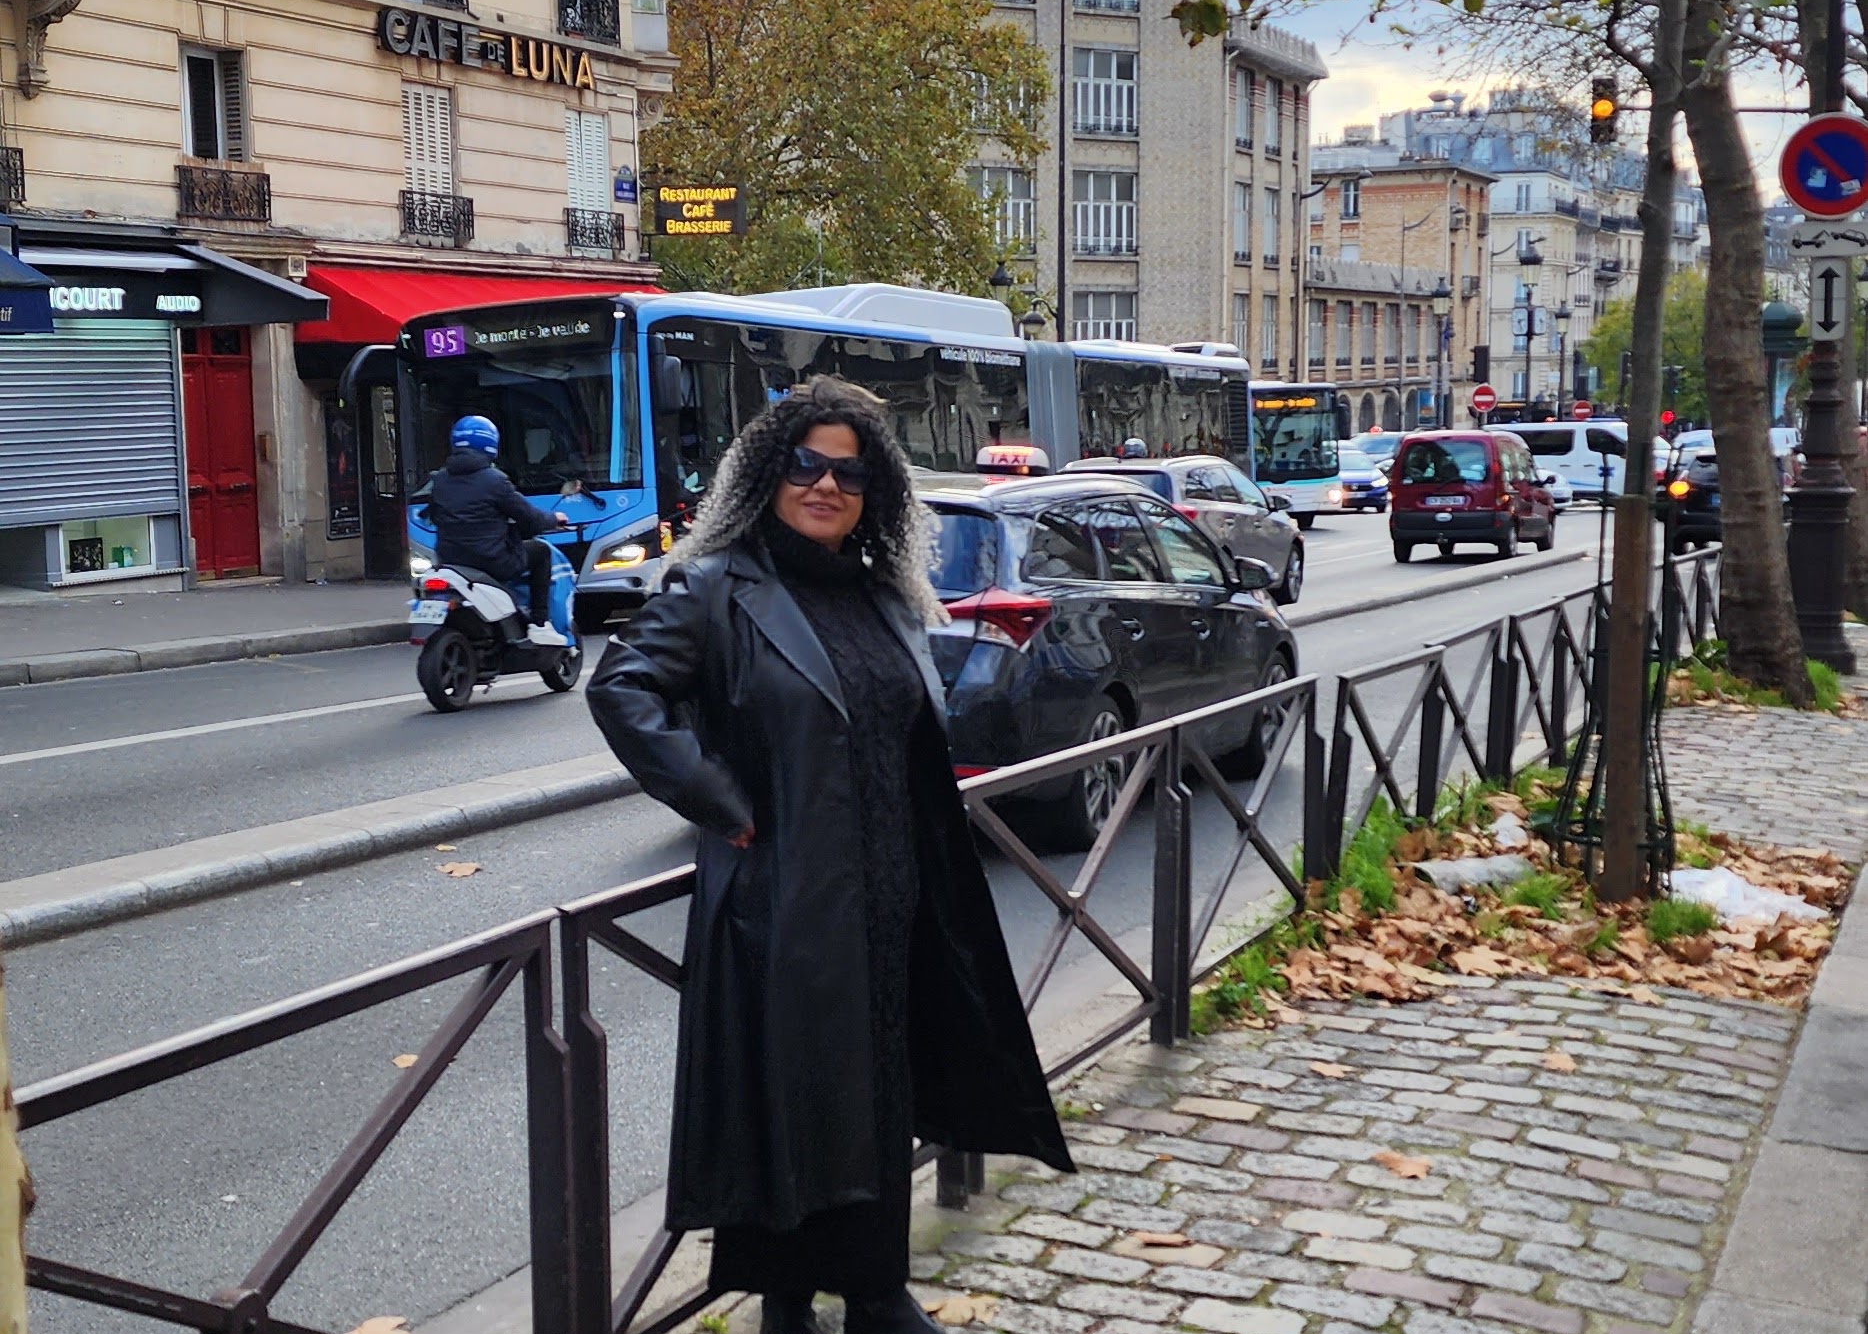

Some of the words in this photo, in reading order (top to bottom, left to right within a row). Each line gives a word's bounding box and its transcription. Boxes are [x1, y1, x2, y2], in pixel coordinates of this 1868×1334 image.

[380, 8, 483, 68] CAFE
[487, 41, 505, 63] DE
[510, 36, 597, 90] LUNA
[660, 187, 737, 202] RESTAURANT
[666, 219, 732, 234] BRASSERIE
[156, 295, 201, 312] AUDIO
[0, 306, 13, 322] tif
[431, 330, 458, 354] 95
[989, 453, 1029, 464] TAXI
